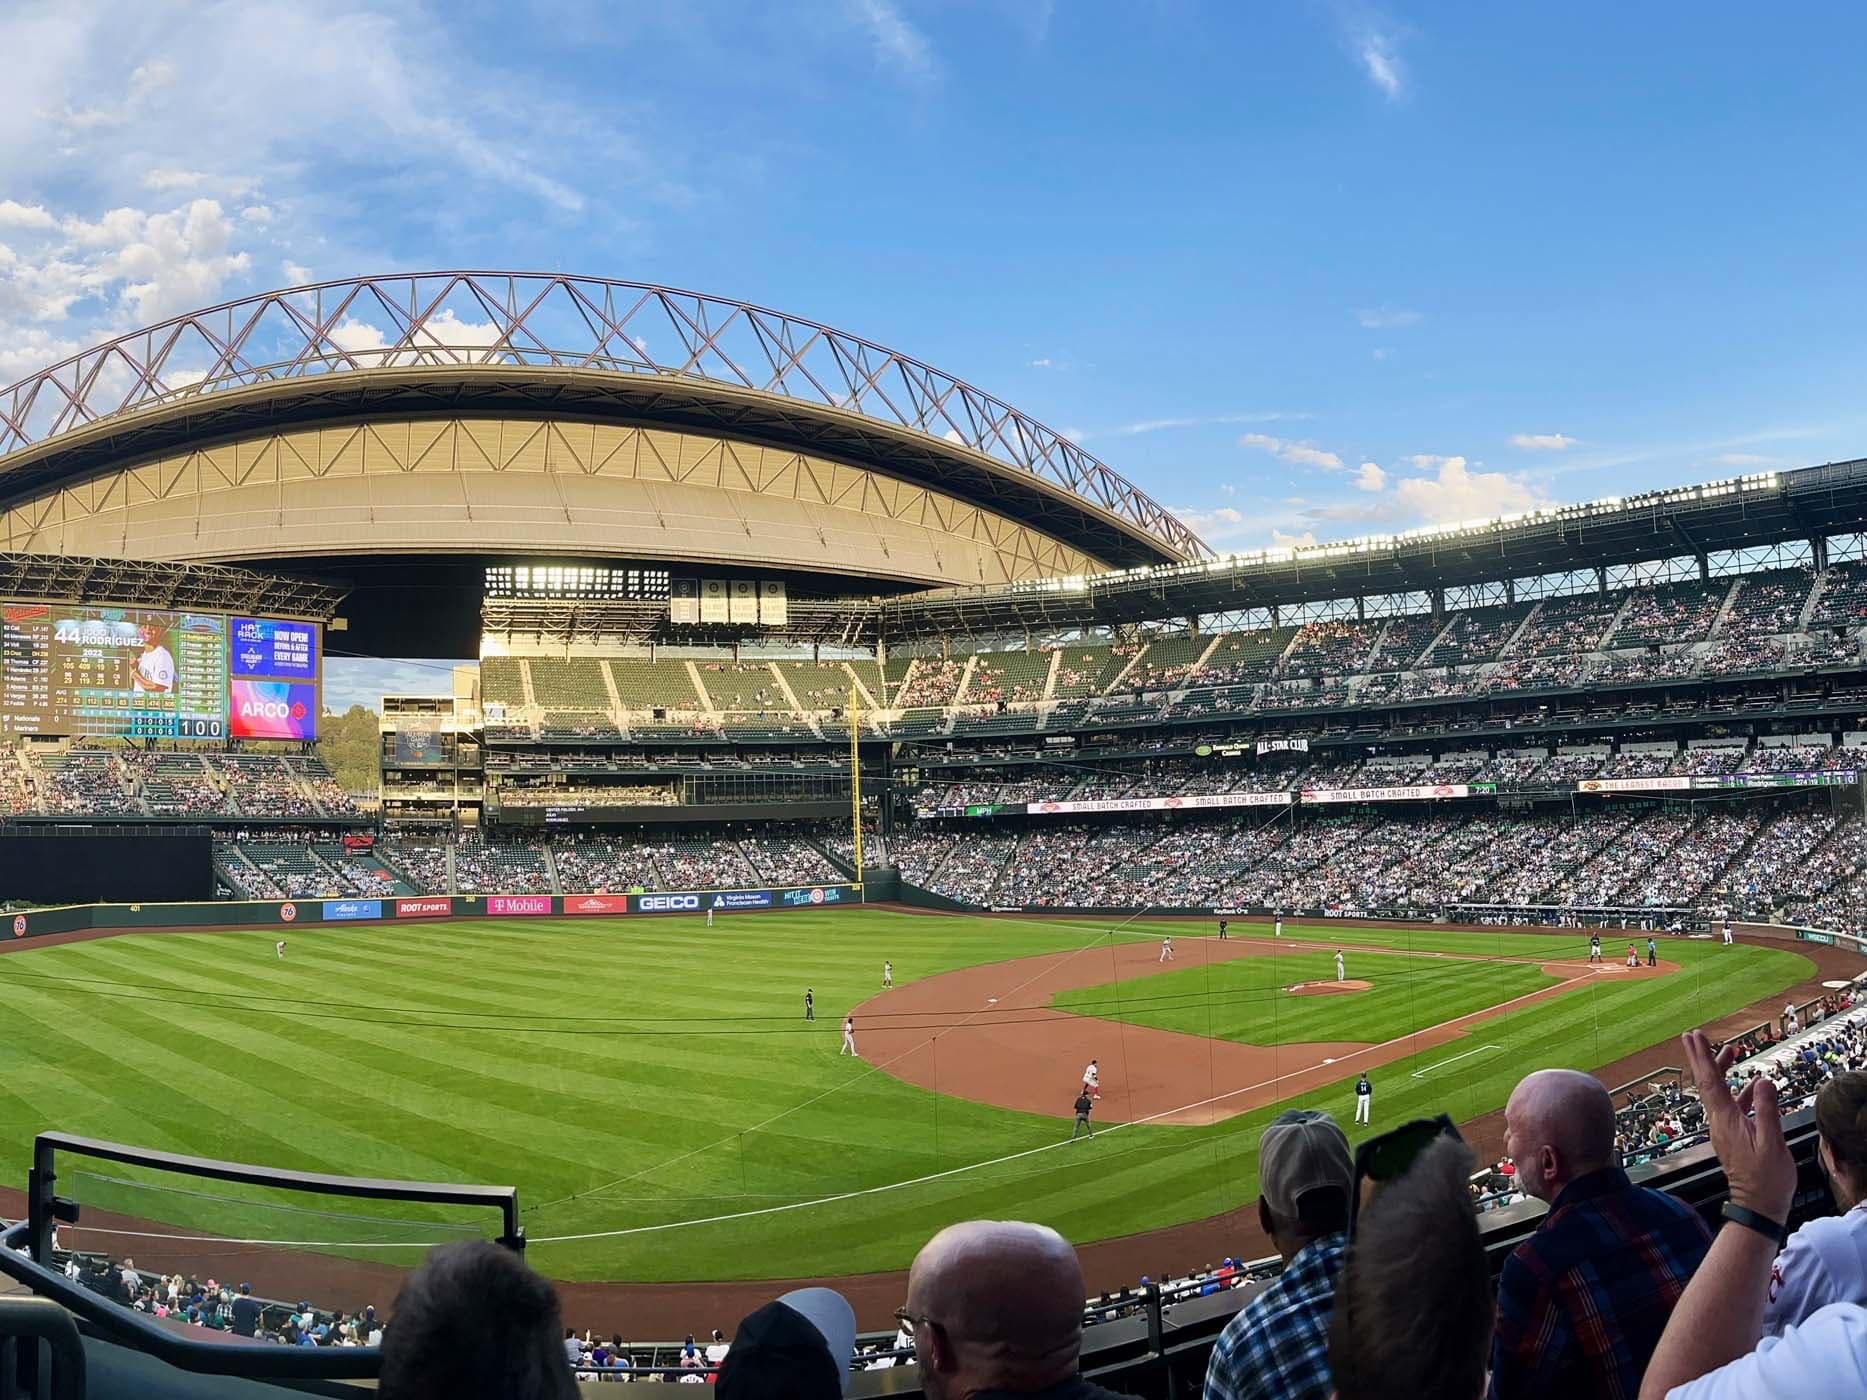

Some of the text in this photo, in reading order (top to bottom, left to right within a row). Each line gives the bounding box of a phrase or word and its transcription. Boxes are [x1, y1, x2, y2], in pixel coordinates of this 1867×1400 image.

[240, 624, 261, 632] HAT
[54, 627, 80, 644] 44
[238, 631, 264, 639] RACK
[82, 636, 145, 647] RODRÍGUEZ
[241, 702, 289, 718] ARCO
[182, 721, 220, 736] 1 0 0
[1290, 739, 1308, 752] CLUB
[1195, 794, 1283, 806] SMALL BATCH CRAFTED
[1330, 789, 1420, 800] SMALL BATCH CRAFTED
[1072, 802, 1094, 810] SMALL
[1121, 800, 1151, 809] CRAFTED
[401, 903, 447, 913] ROOT SPORTS
[495, 900, 543, 912] T Mobile
[640, 896, 698, 910] GEICO
[1324, 909, 1344, 918] ROOT
